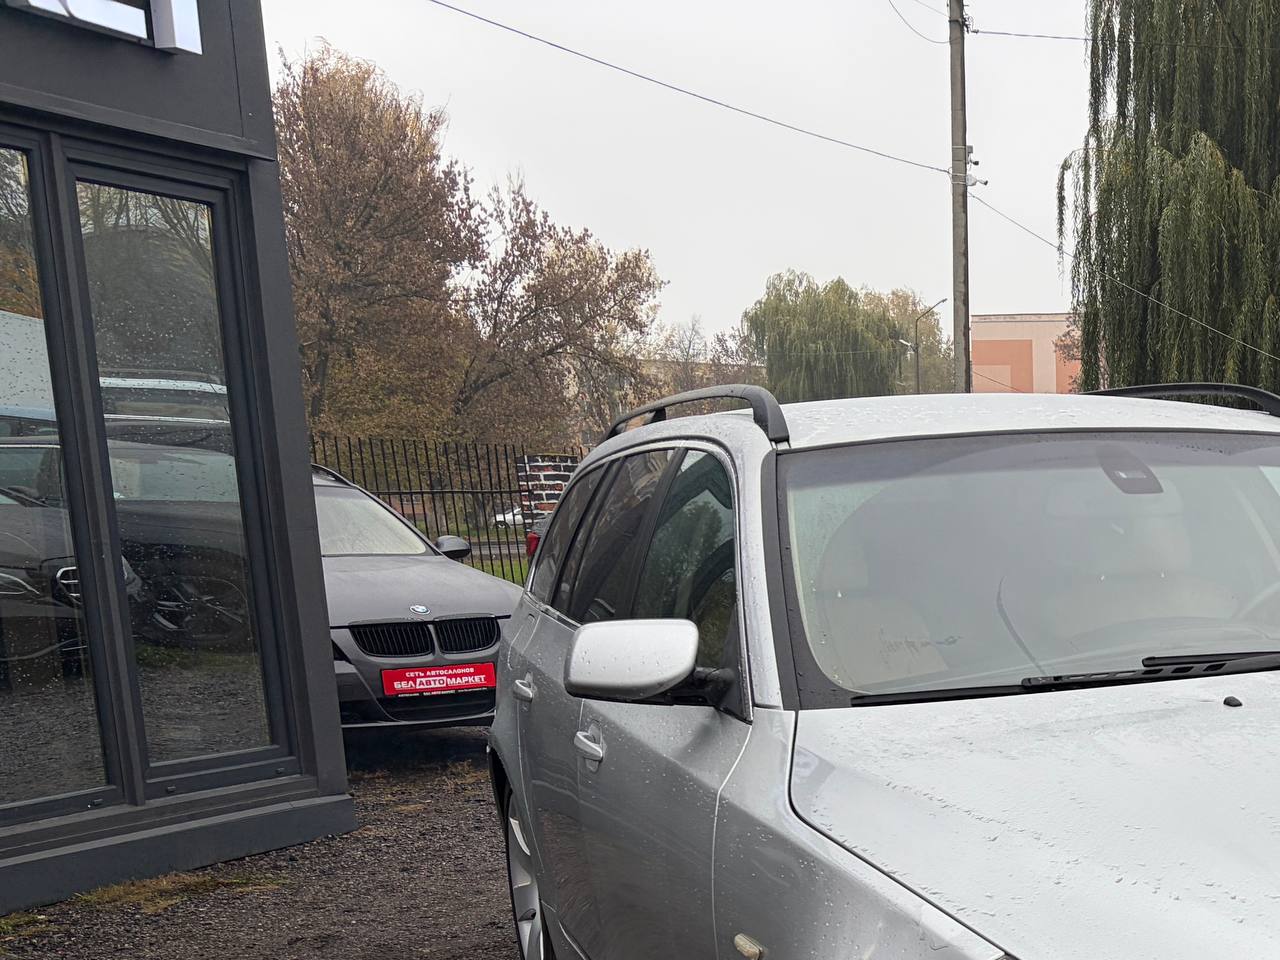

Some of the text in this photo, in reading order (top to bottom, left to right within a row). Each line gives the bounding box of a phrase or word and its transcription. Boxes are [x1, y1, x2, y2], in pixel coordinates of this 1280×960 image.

[394, 675, 486, 689] БЕЛ АВТО МАРКЕТ
